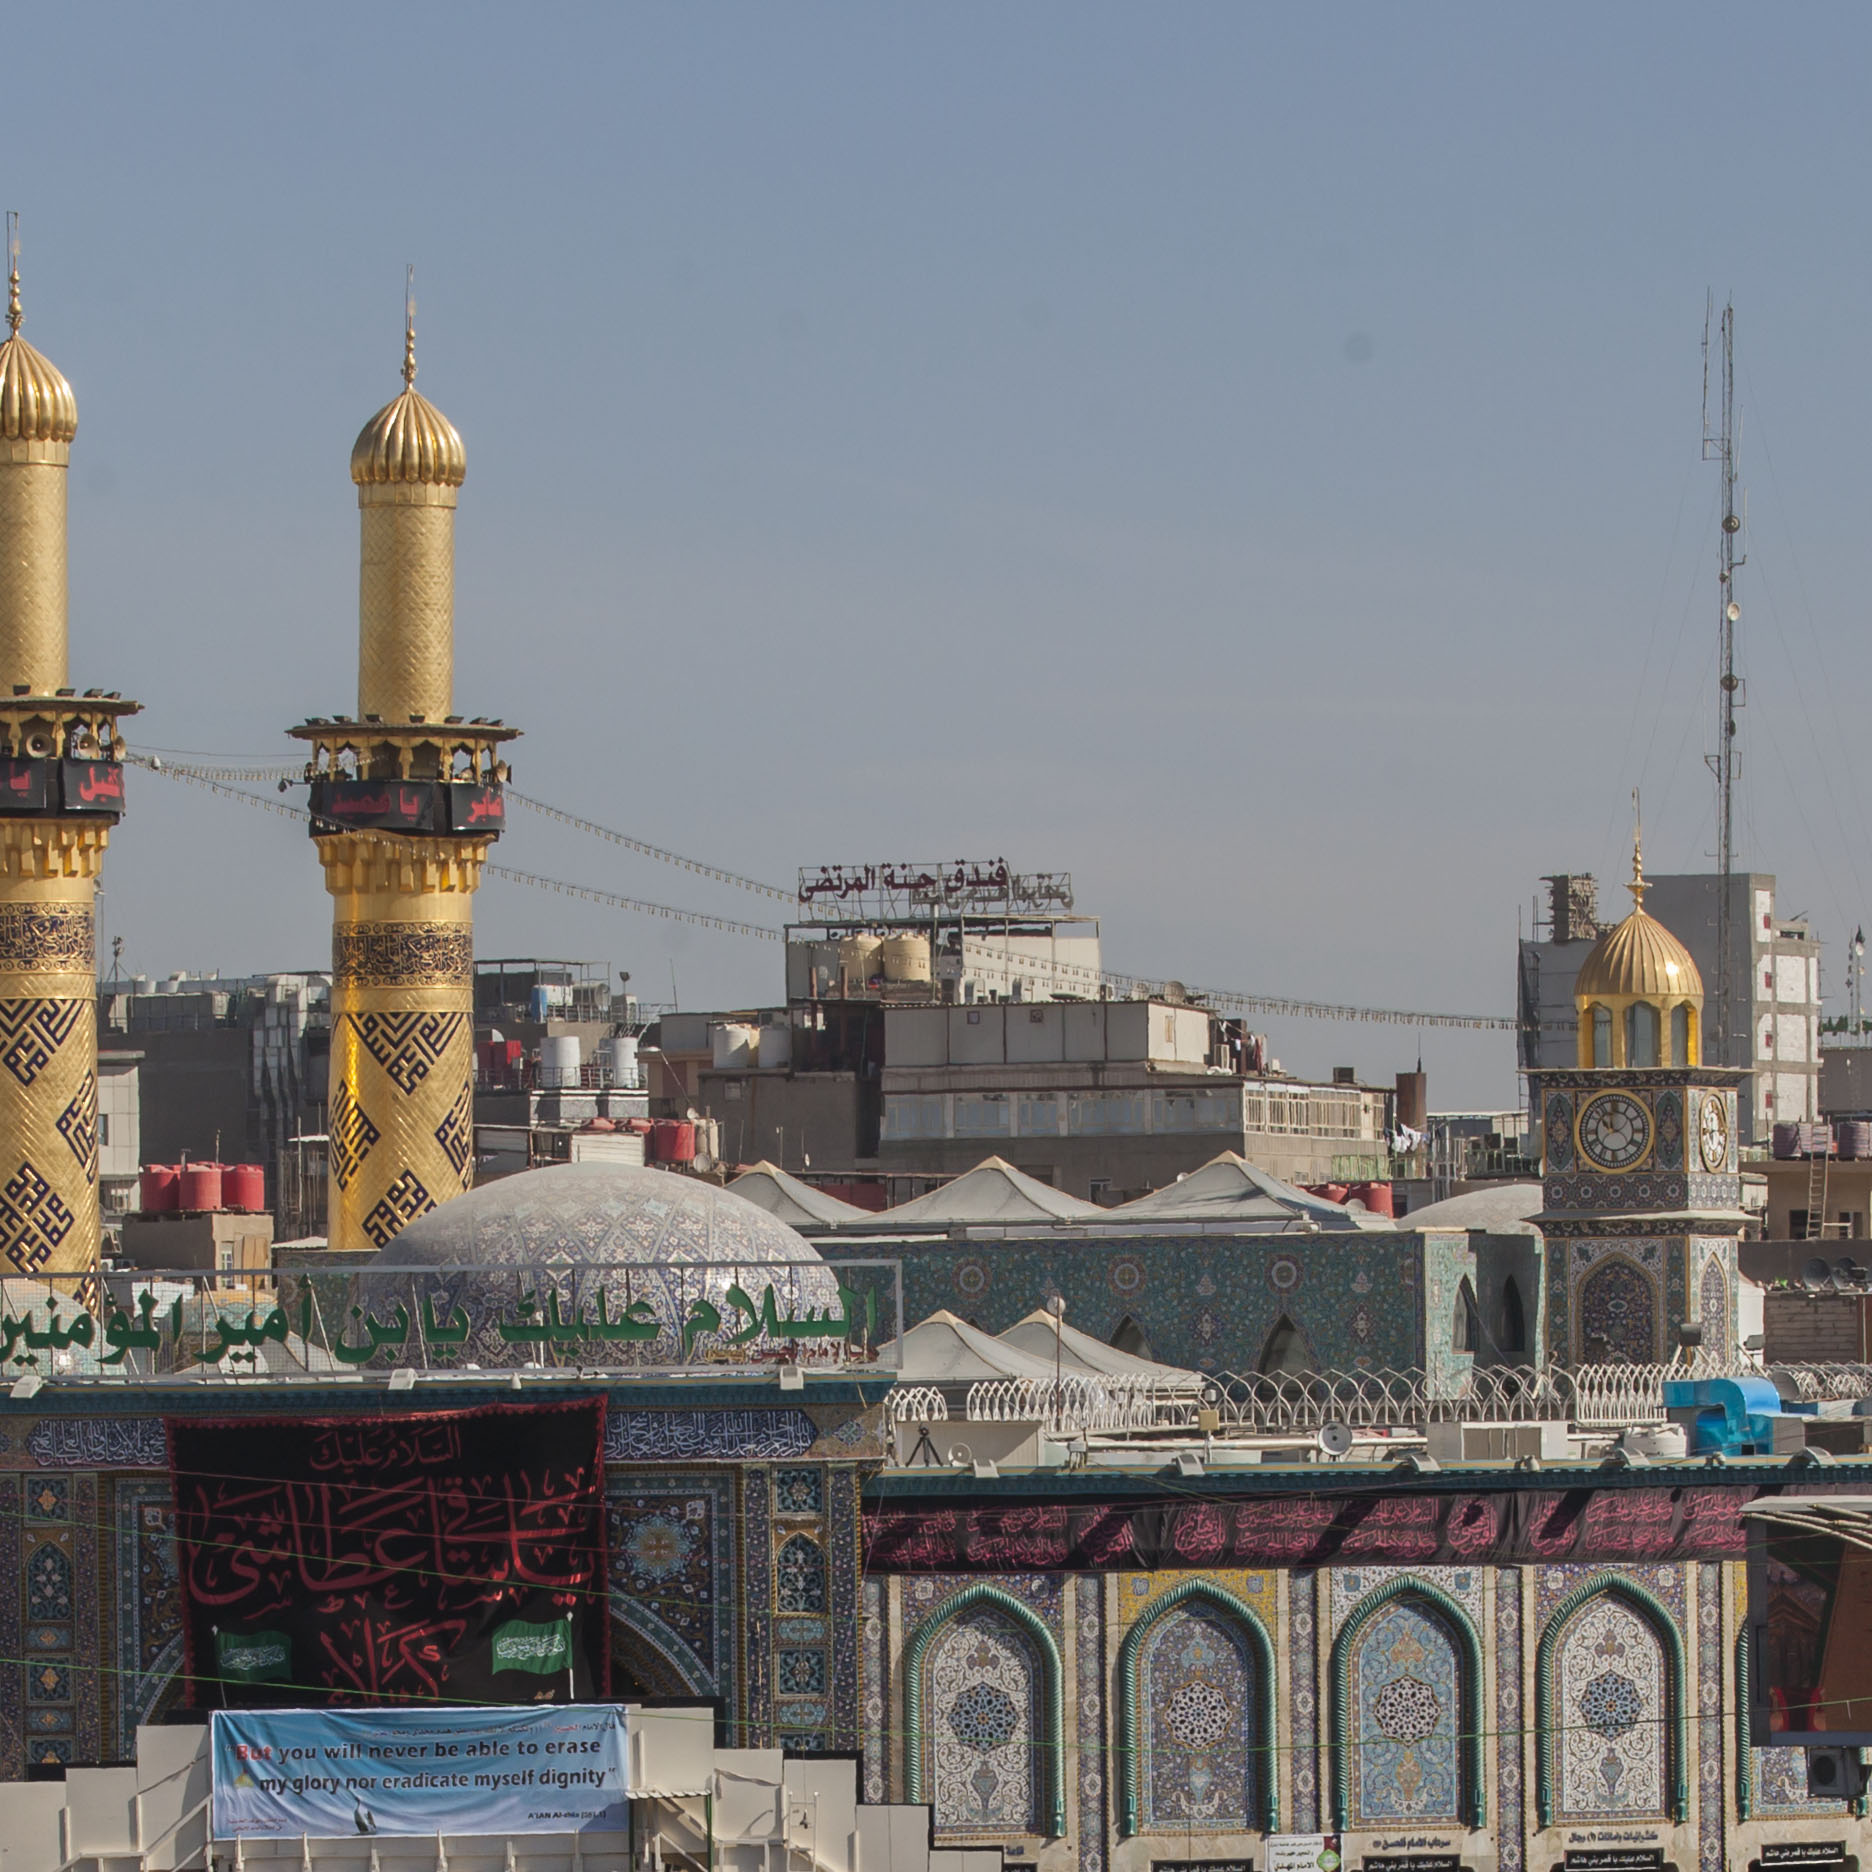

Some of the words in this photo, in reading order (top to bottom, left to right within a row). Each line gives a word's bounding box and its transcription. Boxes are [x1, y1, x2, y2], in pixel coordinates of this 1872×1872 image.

[883, 863, 937, 889] جنة
[945, 856, 1007, 892] فندق
[195, 1275, 314, 1364] أمير
[499, 1285, 660, 1357] عليك
[683, 1283, 876, 1357] السلام
[278, 1748, 316, 1764] you
[325, 1743, 361, 1760] will
[368, 1747, 426, 1760] never
[435, 1742, 458, 1757] be
[466, 1741, 509, 1756] able
[518, 1741, 538, 1755] to
[545, 1740, 600, 1754] erase
[260, 1778, 287, 1795] my
[292, 1775, 340, 1795] glory
[345, 1777, 377, 1791] nor
[382, 1772, 468, 1790] eradicate
[474, 1769, 534, 1790] myself
